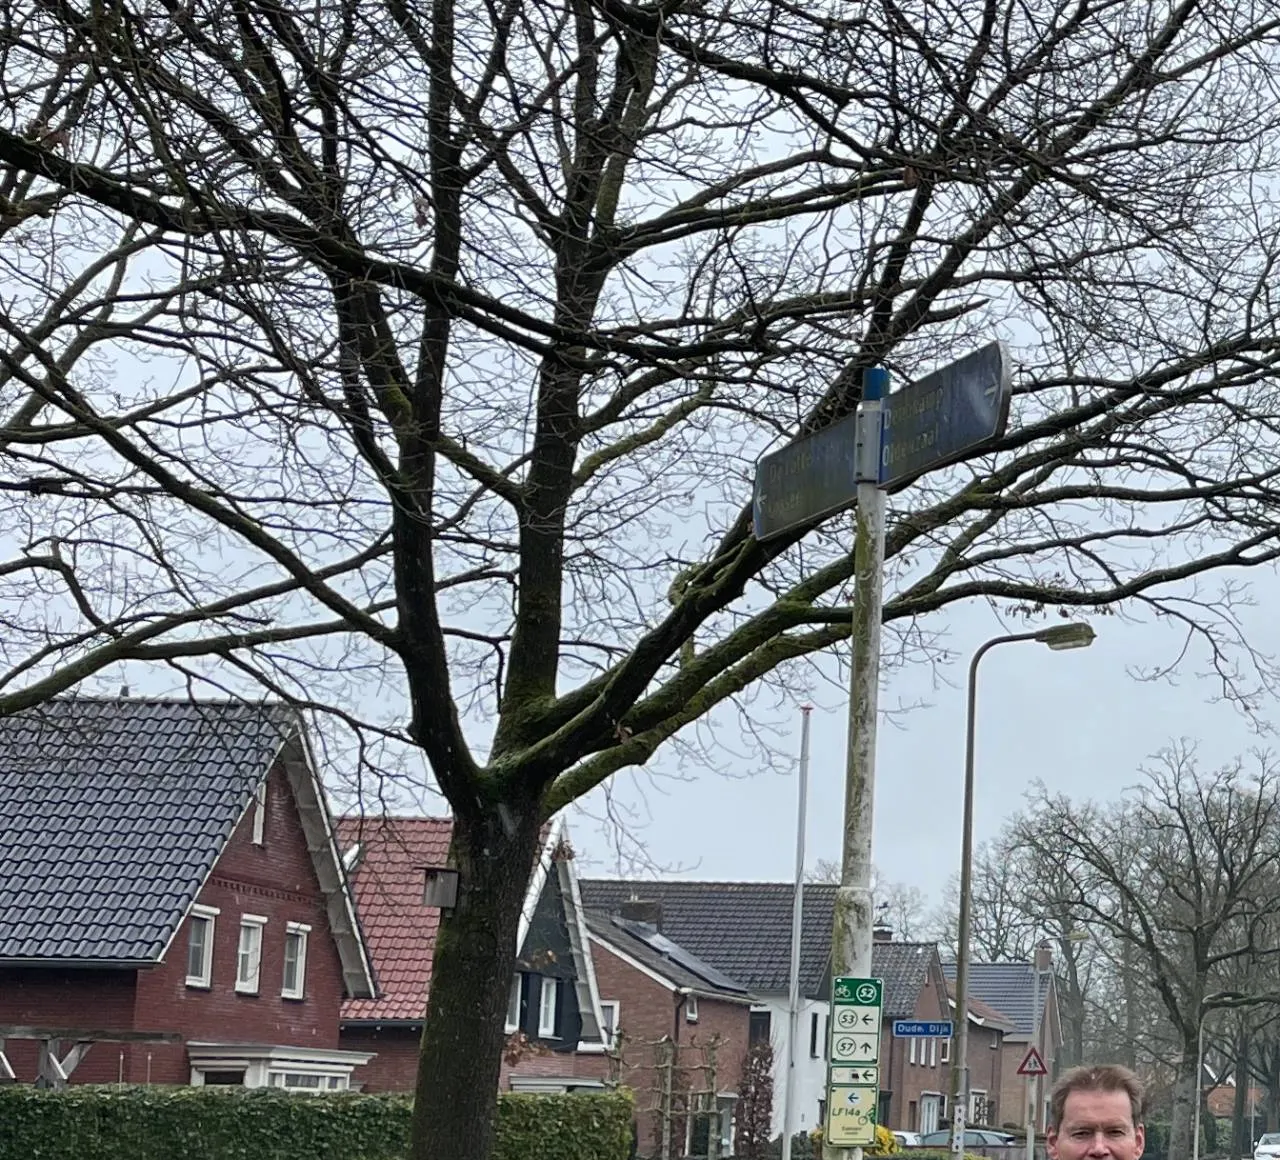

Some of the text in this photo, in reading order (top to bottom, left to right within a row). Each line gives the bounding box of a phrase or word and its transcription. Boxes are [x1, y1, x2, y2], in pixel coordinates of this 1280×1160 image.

[860, 987, 874, 998] 52
[841, 1014, 855, 1024] 53
[840, 1042, 854, 1051] 57
